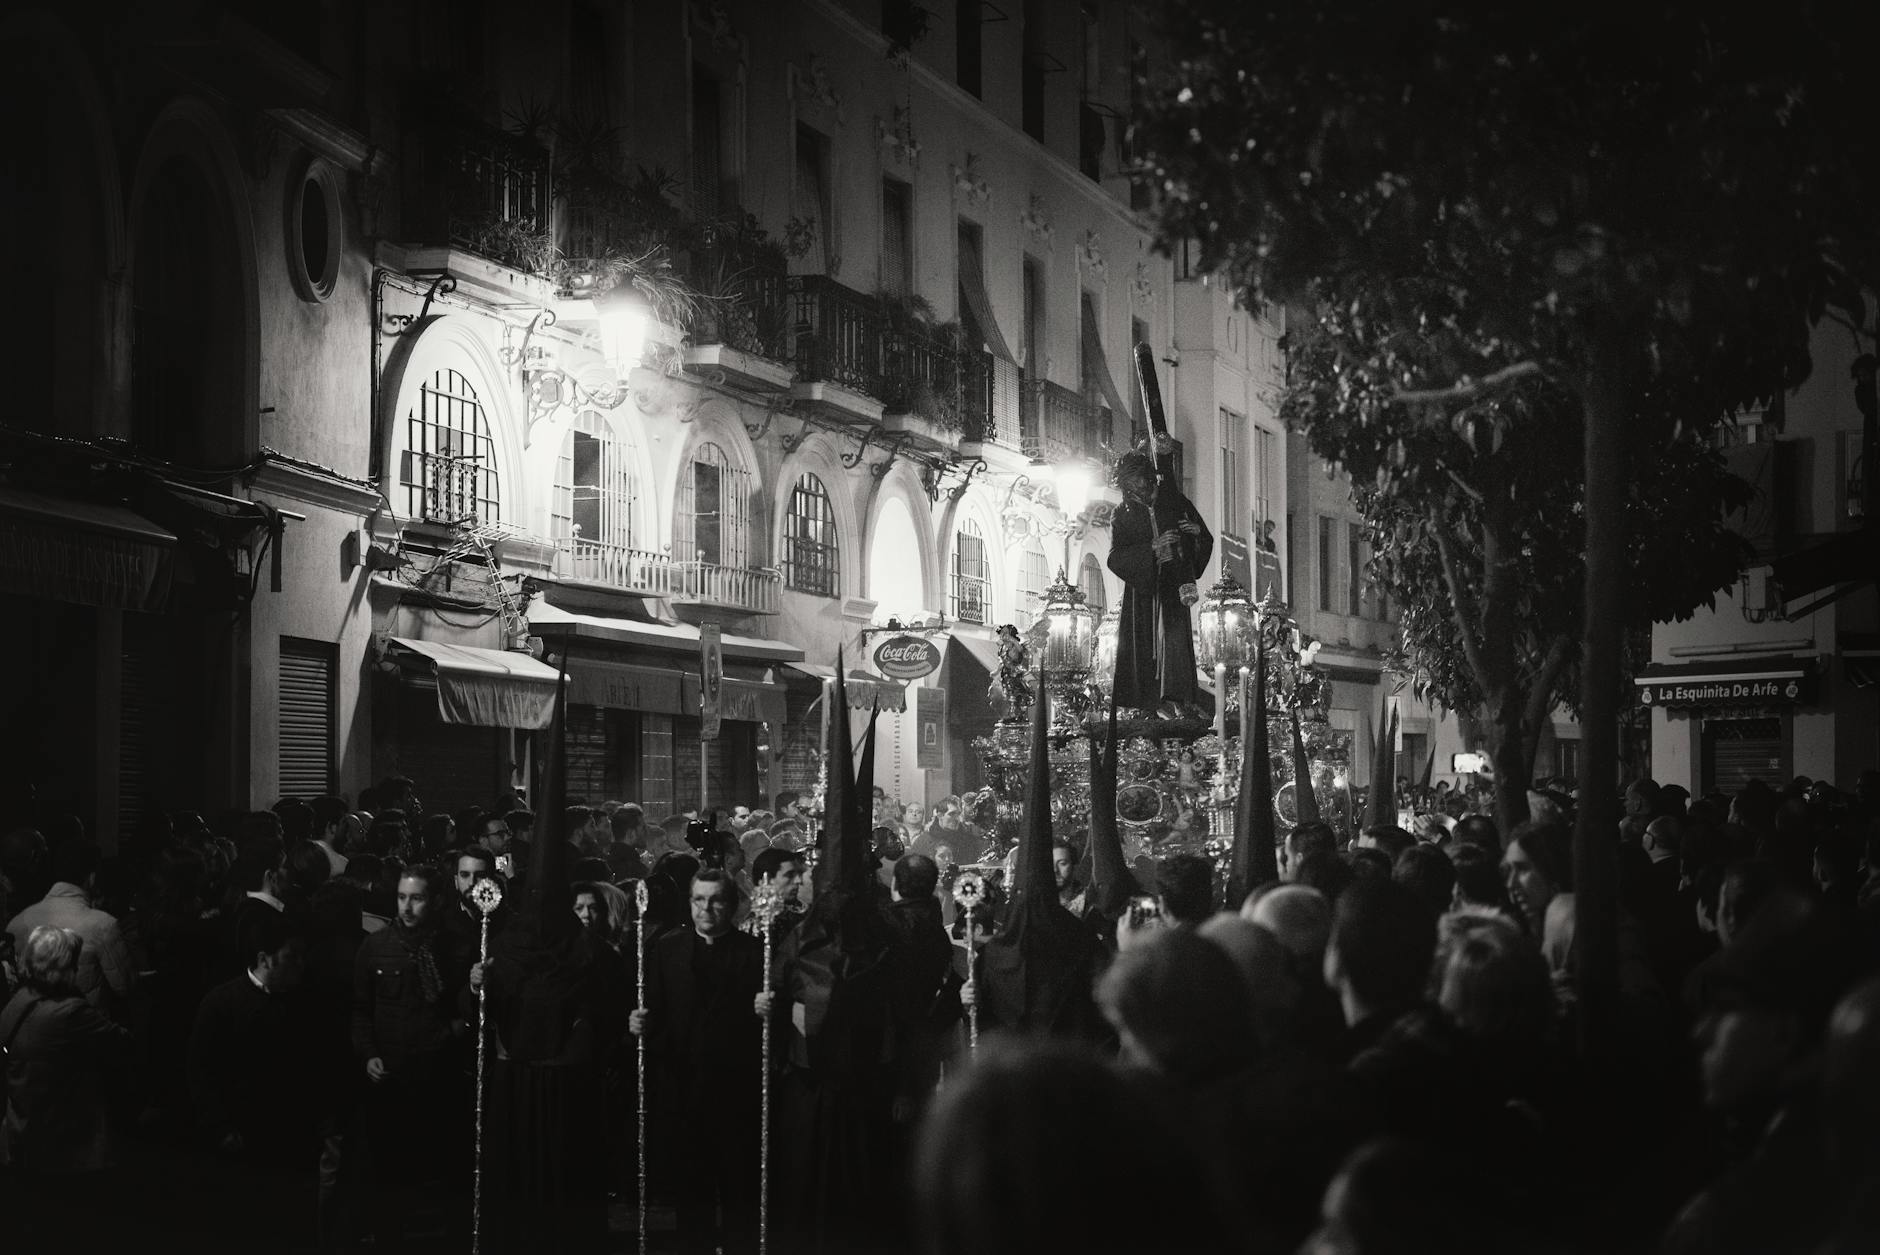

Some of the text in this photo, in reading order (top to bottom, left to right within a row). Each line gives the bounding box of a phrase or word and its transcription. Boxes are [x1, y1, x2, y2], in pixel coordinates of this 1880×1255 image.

[1659, 682, 1779, 702] La Esquinita De Arfe
